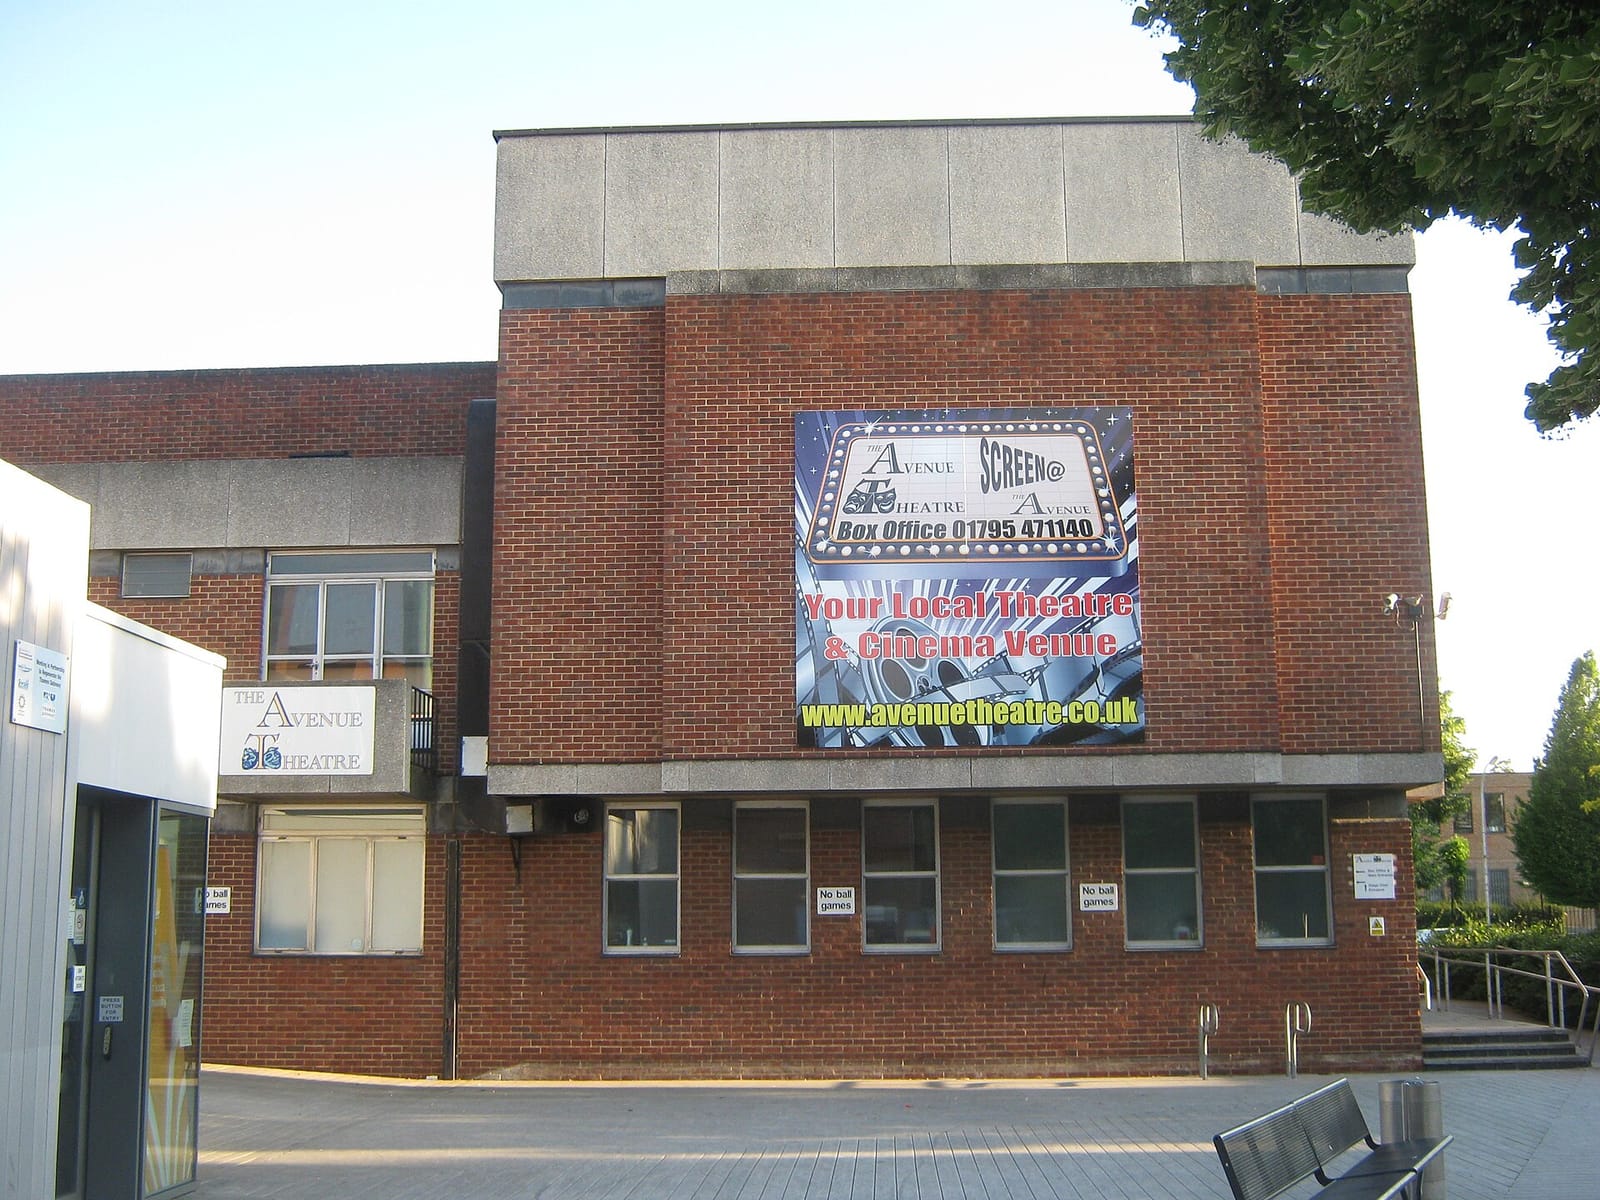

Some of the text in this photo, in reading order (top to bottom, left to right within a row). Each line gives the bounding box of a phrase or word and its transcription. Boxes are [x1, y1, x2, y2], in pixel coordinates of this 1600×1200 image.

[862, 441, 955, 475] AVENUE
[867, 443, 883, 453] THE
[1010, 492, 1092, 515] AVENUE
[837, 518, 1094, 540] Box Office 01795 471140
[804, 590, 1134, 621] Your Local Theatre
[824, 630, 1119, 661] & Cinema Venue
[234, 691, 265, 705] THE
[256, 691, 363, 728] AVENUE
[801, 697, 1139, 728] www.avenuetheatre.co.uk
[243, 733, 361, 770] THEATRE
[213, 889, 228, 898] ball
[820, 889, 852, 899] No ball
[1082, 885, 1115, 895] No ball
[821, 902, 852, 912] games
[1083, 898, 1114, 908] games
